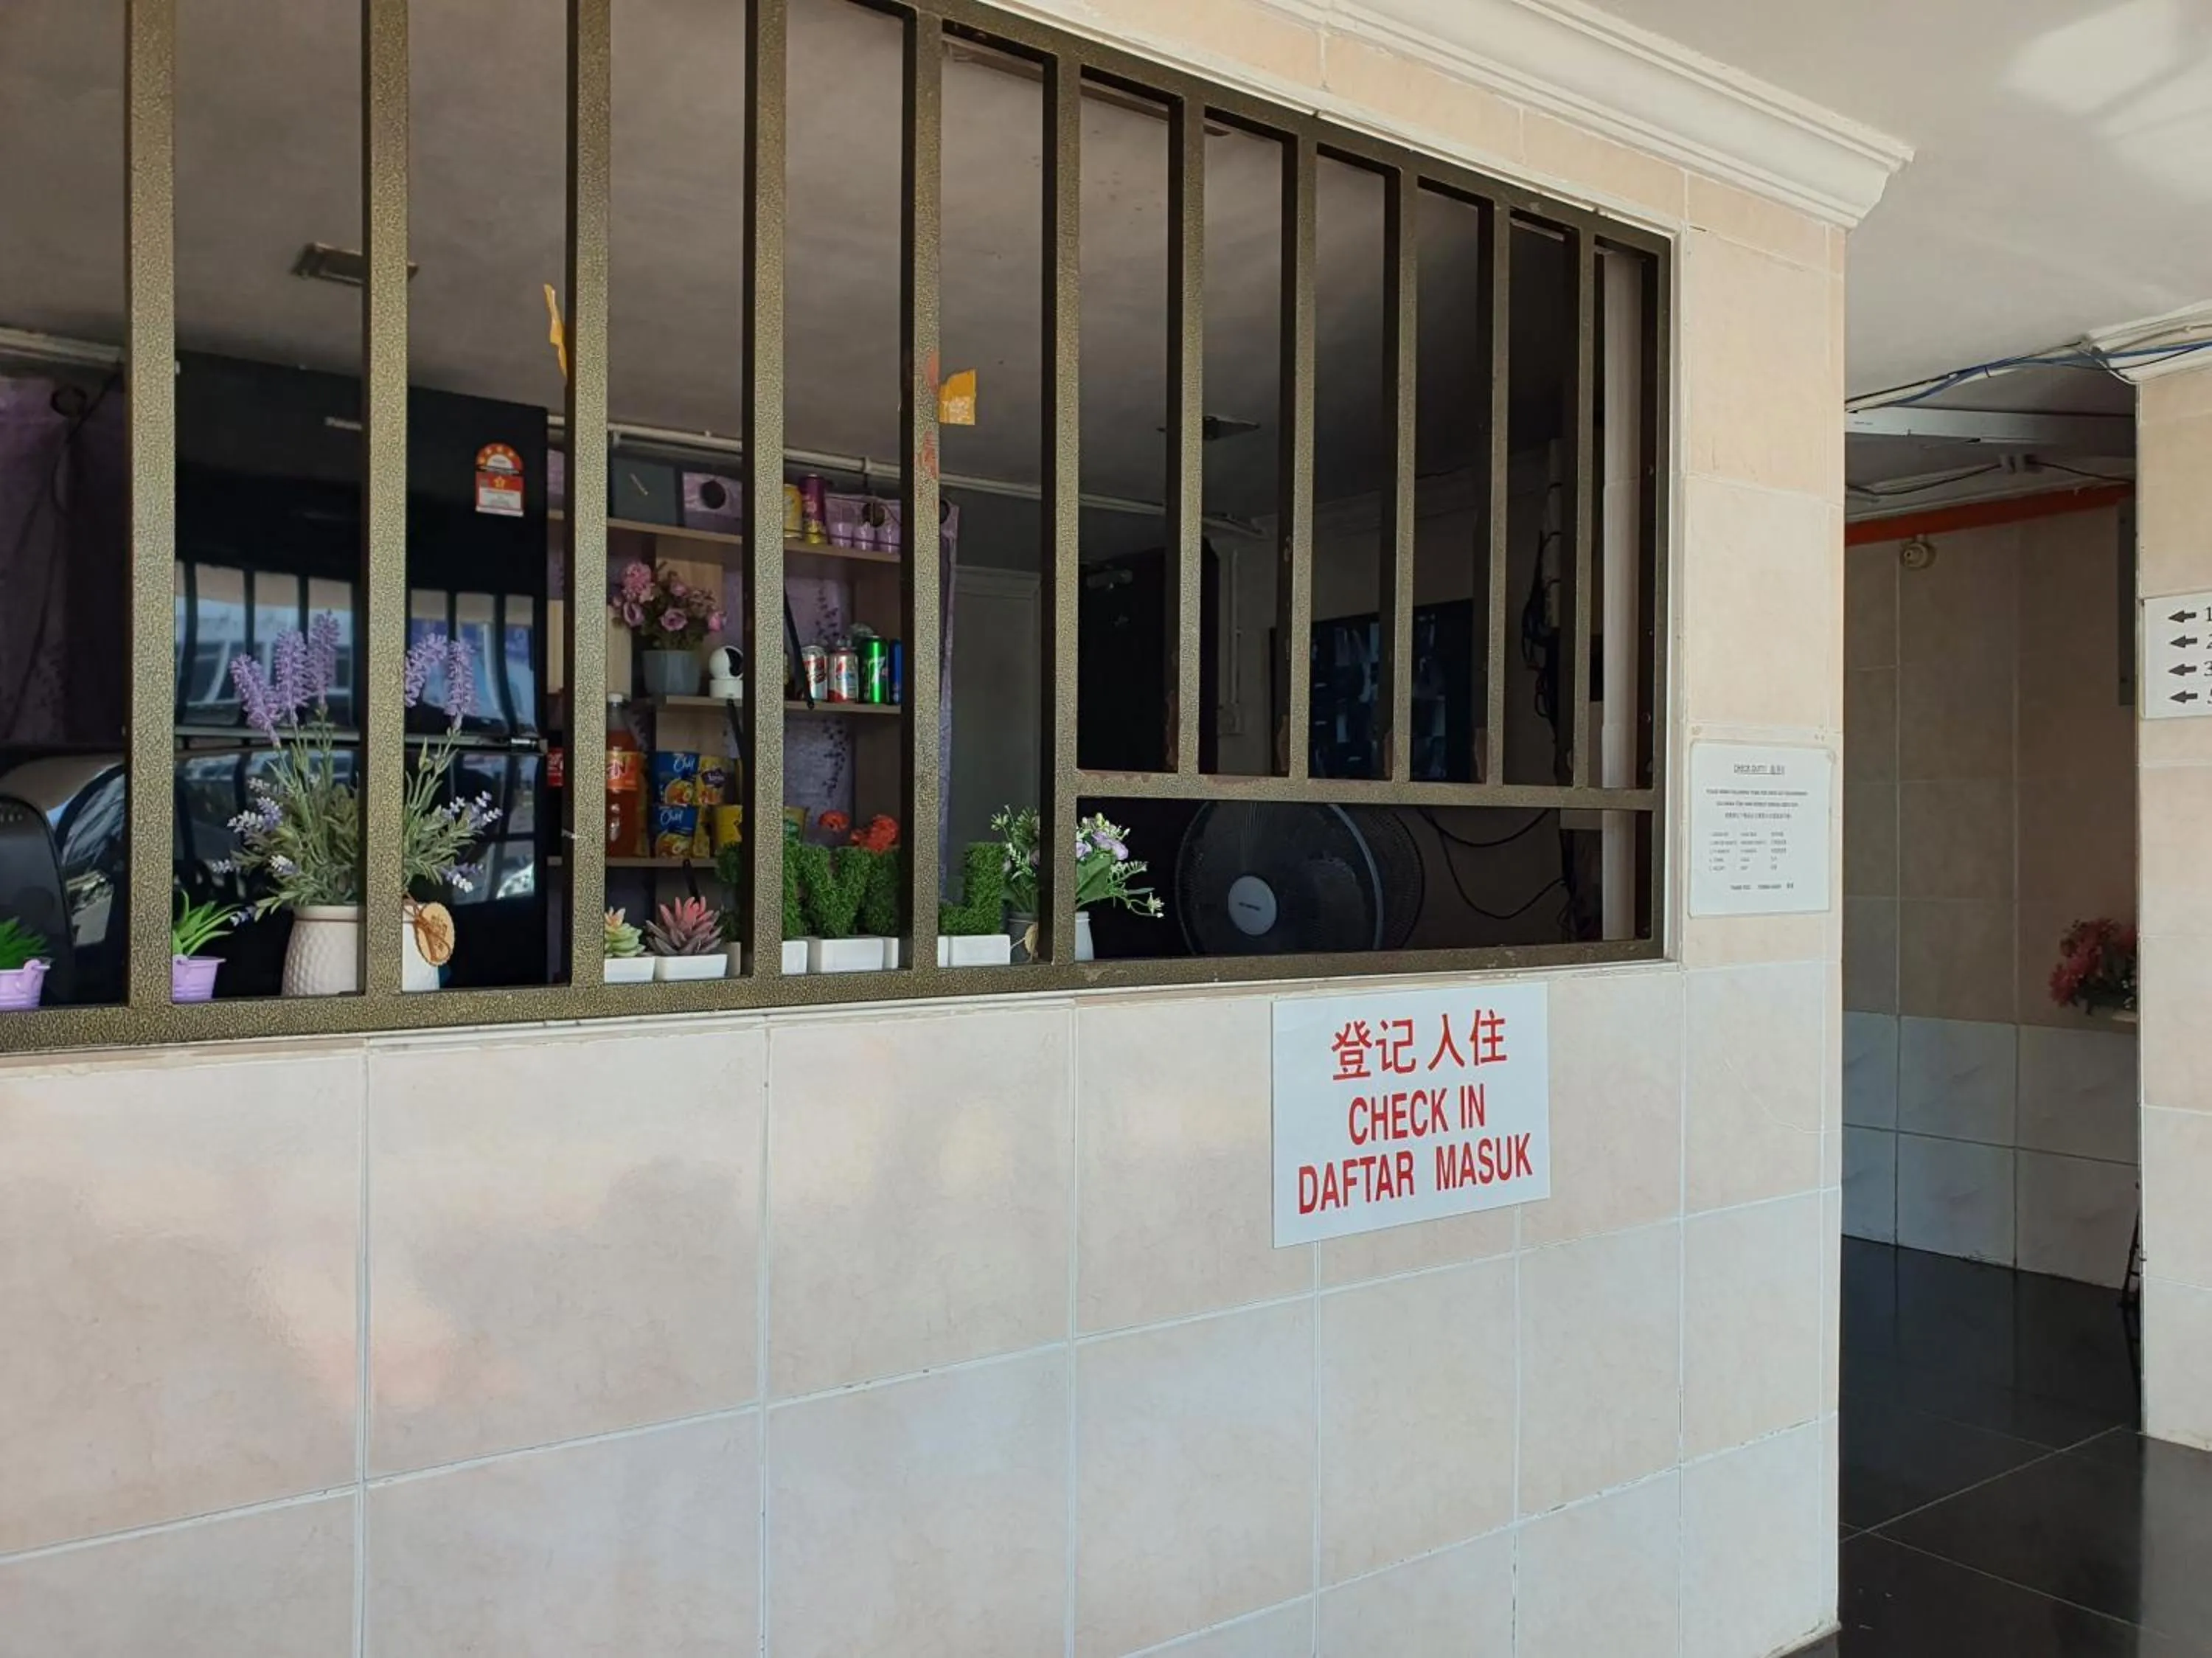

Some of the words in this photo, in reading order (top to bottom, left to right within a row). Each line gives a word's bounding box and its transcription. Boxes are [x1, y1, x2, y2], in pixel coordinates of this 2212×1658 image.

[1349, 1088, 1449, 1145] CHECK
[1459, 1084, 1486, 1129] IN
[1298, 1151, 1415, 1215] DAFTAR
[1435, 1134, 1533, 1191] MASUK
